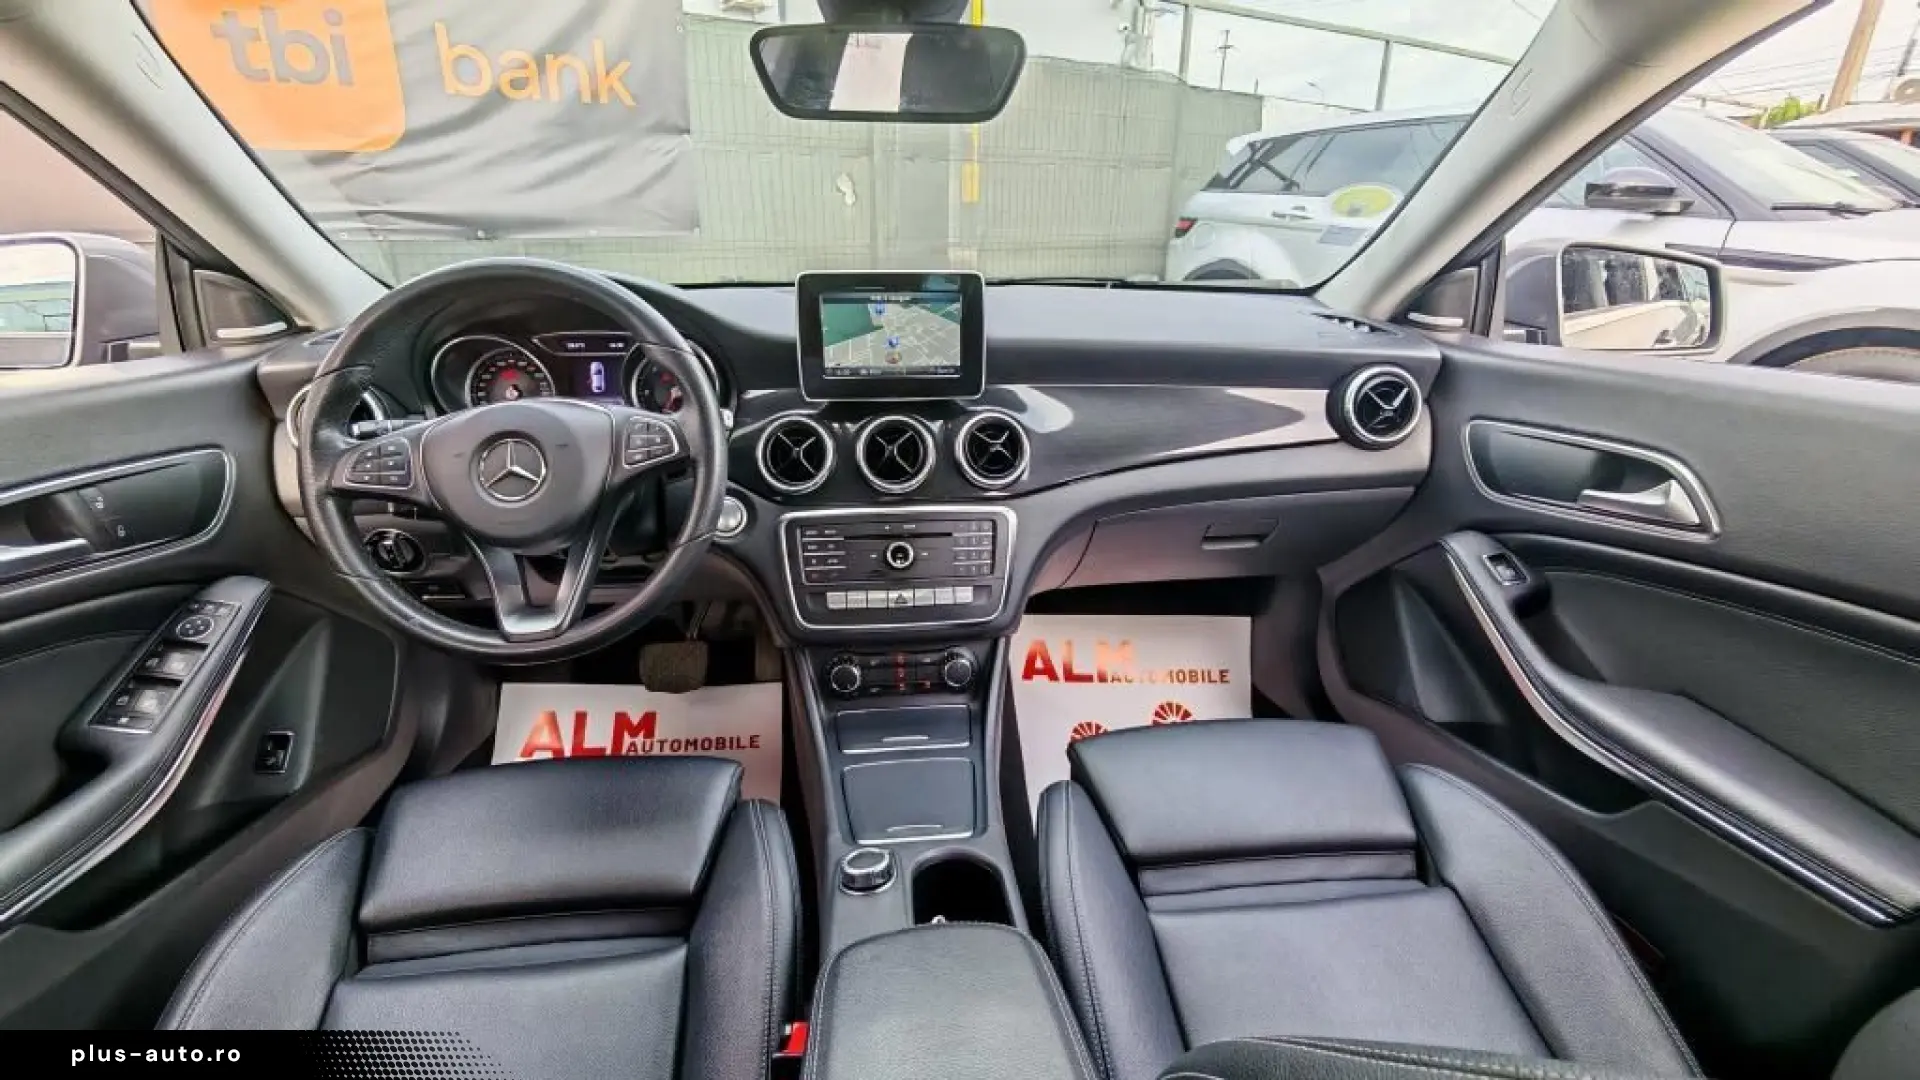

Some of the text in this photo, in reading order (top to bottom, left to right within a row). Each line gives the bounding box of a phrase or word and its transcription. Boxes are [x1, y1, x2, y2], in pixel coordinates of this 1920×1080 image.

[211, 7, 636, 107] tbi bank
[1021, 639, 1135, 683] ALM
[519, 710, 761, 758] ALM AUTOMOBILE
